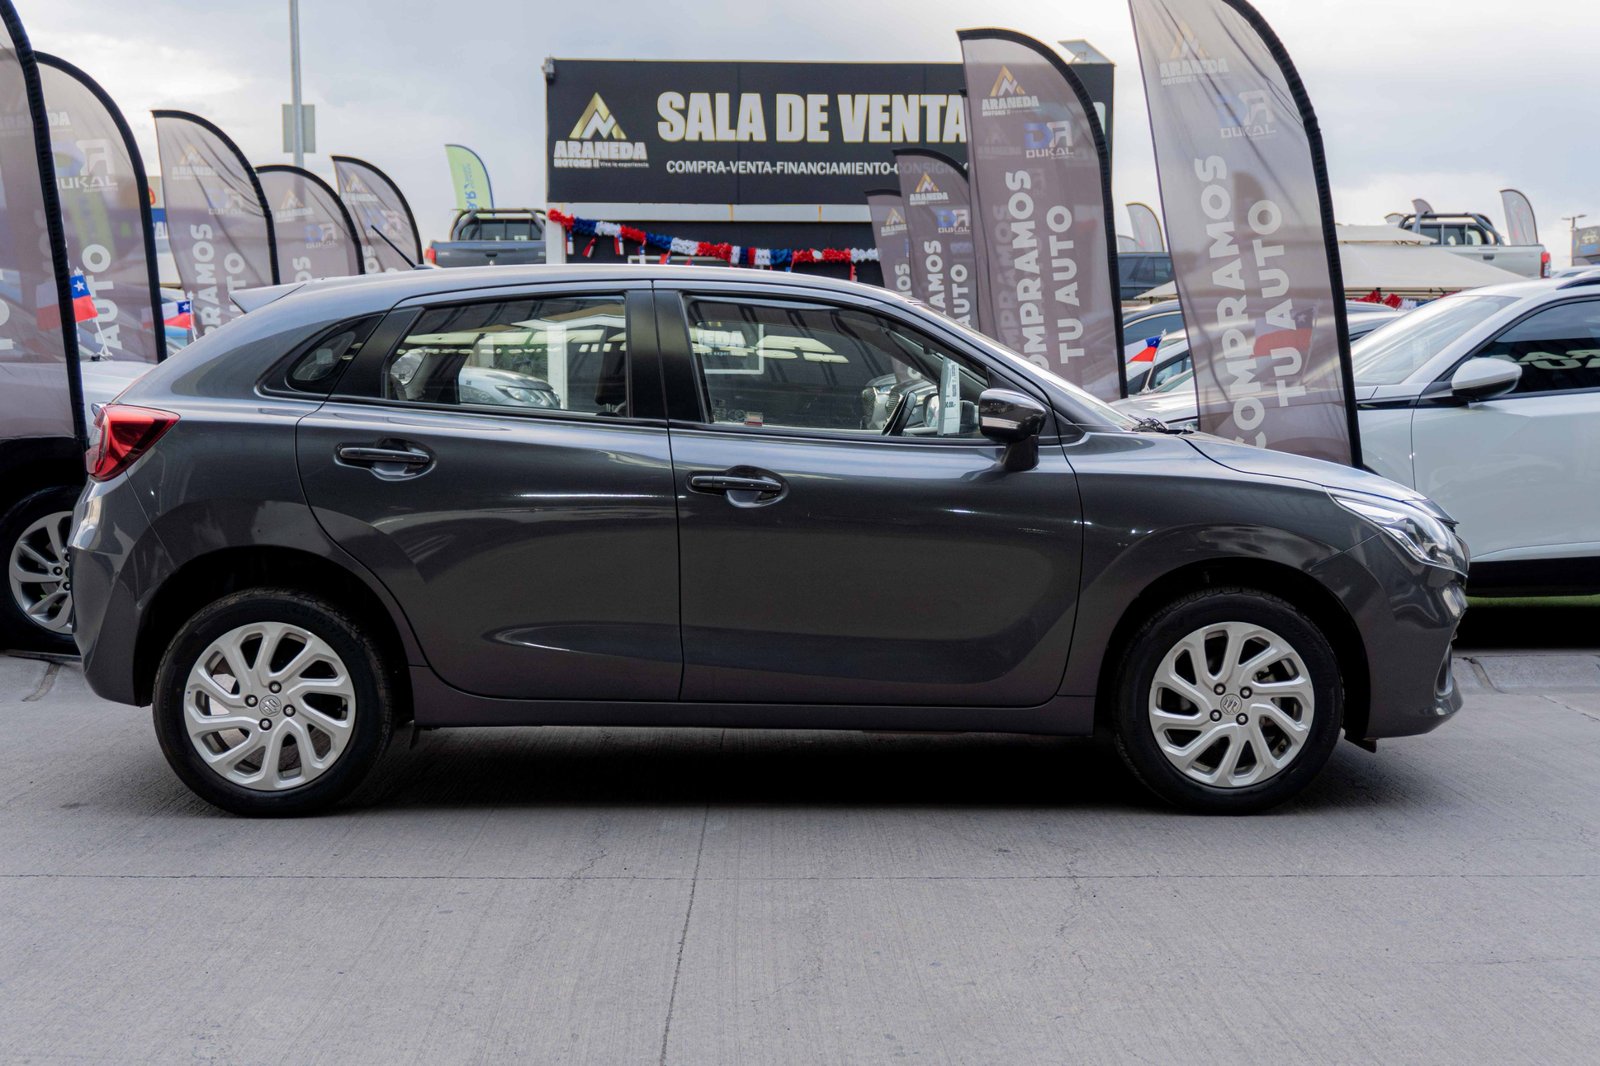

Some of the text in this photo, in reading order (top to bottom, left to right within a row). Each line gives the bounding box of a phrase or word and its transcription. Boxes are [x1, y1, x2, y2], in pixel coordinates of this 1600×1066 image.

[657, 91, 767, 142] SALA
[776, 93, 829, 142] DE
[982, 95, 1040, 111] ARANEDA
[554, 141, 648, 160] ARANEDA
[1025, 147, 1075, 159] DUKAL
[1220, 124, 1277, 138] DUKAL
[57, 175, 118, 190] UKAL
[190, 223, 222, 337] RAMOS
[1005, 170, 1050, 371] OMPRAMOS
[1046, 205, 1085, 364] TU AUTO
[82, 244, 123, 350] AUTO
[1248, 199, 1306, 407] TU AUTO
